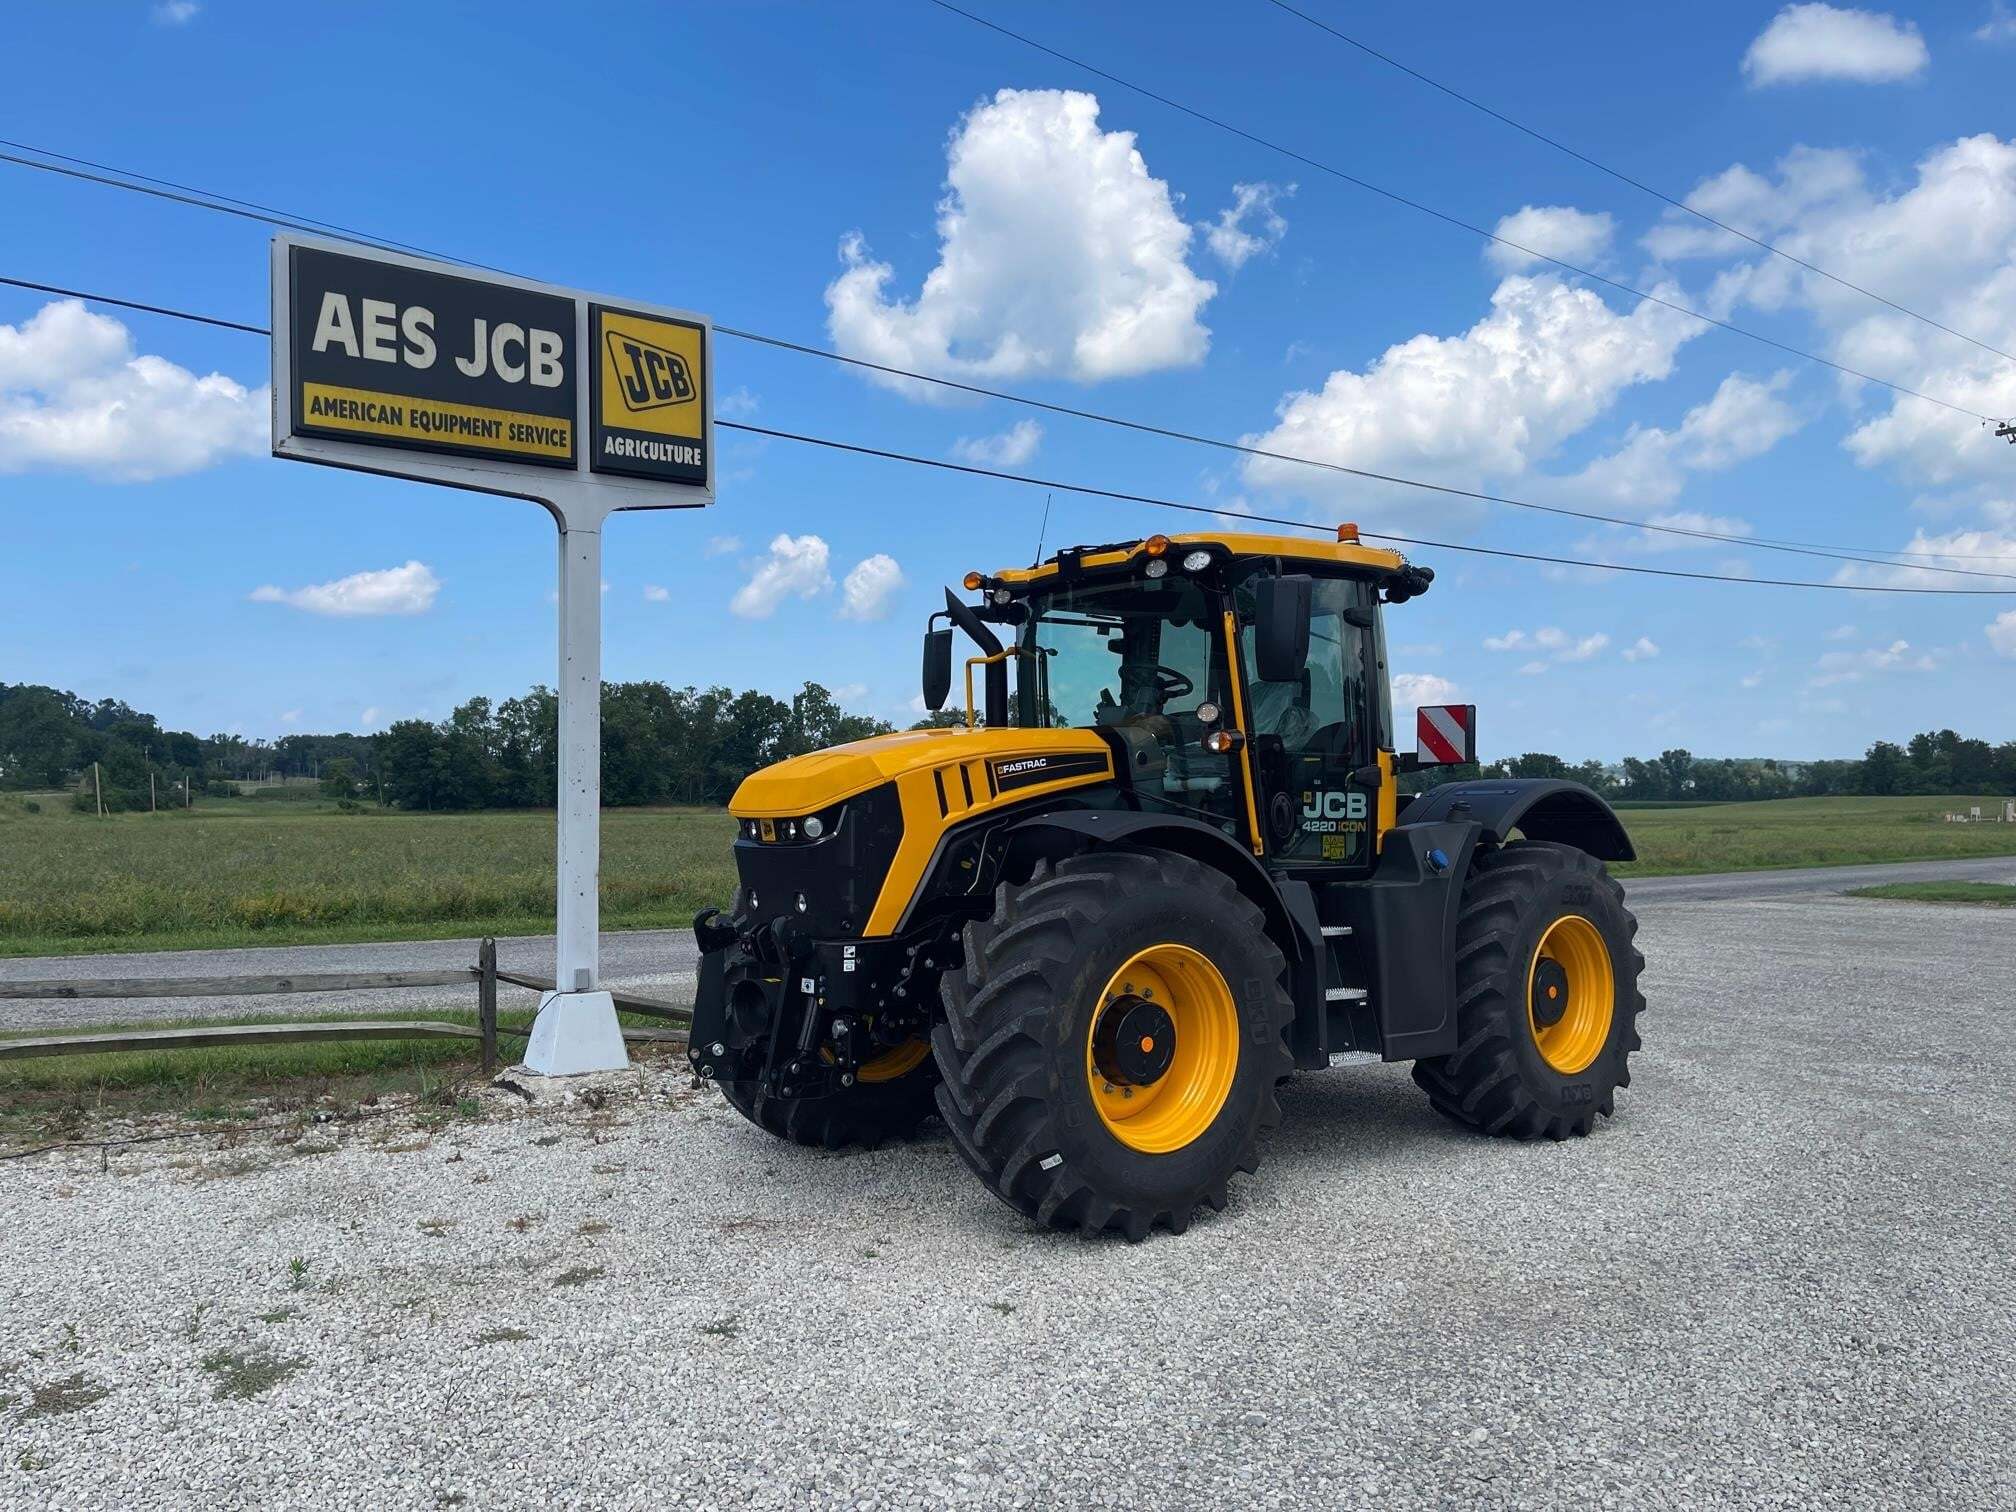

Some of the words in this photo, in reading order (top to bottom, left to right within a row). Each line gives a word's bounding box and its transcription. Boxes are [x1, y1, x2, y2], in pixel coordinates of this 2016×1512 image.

[312, 291, 437, 369] AES
[455, 318, 564, 388] JCB
[623, 342, 690, 403] JCB
[310, 396, 403, 426] AMERICAN
[410, 409, 502, 439] EQUIPMENT
[508, 423, 567, 448] SERVICE
[604, 436, 702, 466] AGRICULTURE
[1003, 758, 1047, 774] FASTRAC
[1303, 791, 1367, 819] JCB
[1302, 821, 1336, 832] 4220
